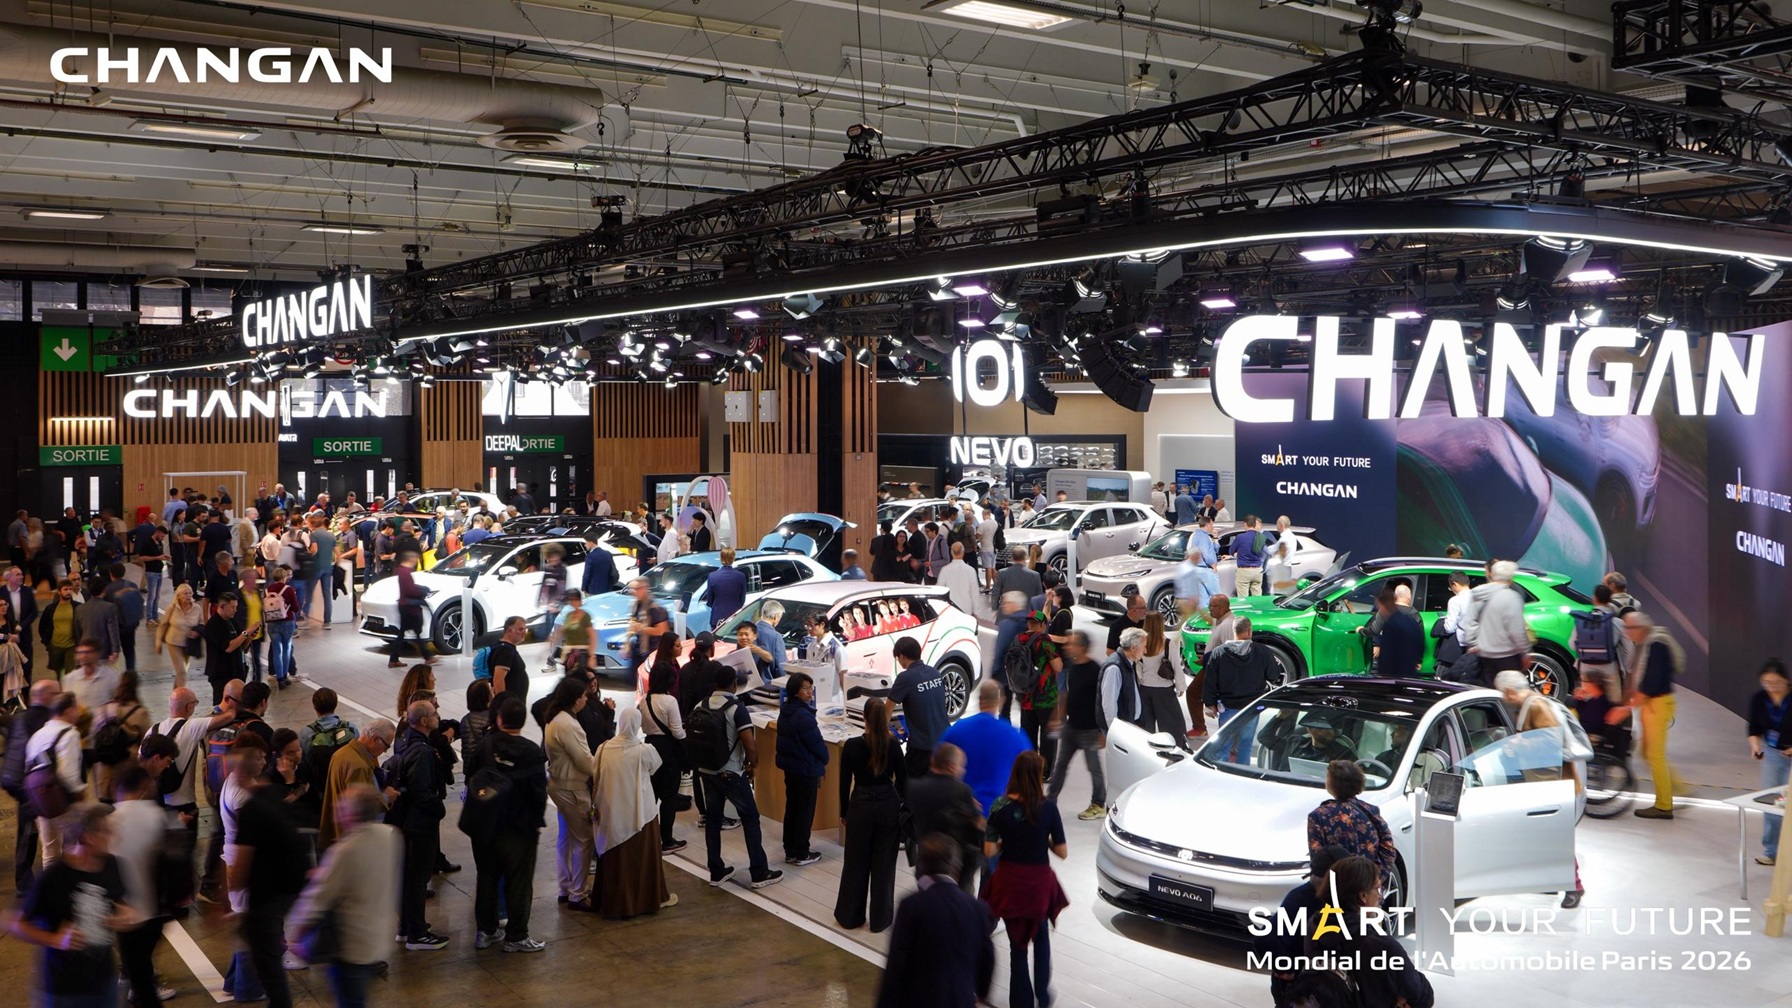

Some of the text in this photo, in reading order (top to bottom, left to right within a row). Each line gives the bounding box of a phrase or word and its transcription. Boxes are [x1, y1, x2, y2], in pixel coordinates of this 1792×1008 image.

[242, 274, 371, 347] CHANGAN
[1213, 314, 1766, 423] CHANGAN
[323, 441, 372, 453] SORTIE
[485, 435, 524, 452] DEEPAL
[522, 438, 555, 450] ORTIE
[950, 436, 1034, 468] NEVO
[52, 449, 110, 463] SORTIE
[1261, 444, 1371, 468] SMART YOUR FUTURE
[1276, 481, 1358, 499] CHANGAN
[1725, 467, 1792, 513] SMART YOUR FUTURE
[1736, 530, 1785, 567] CHANGAN
[917, 677, 943, 693] STAFF
[1157, 885, 1181, 897] NEVO
